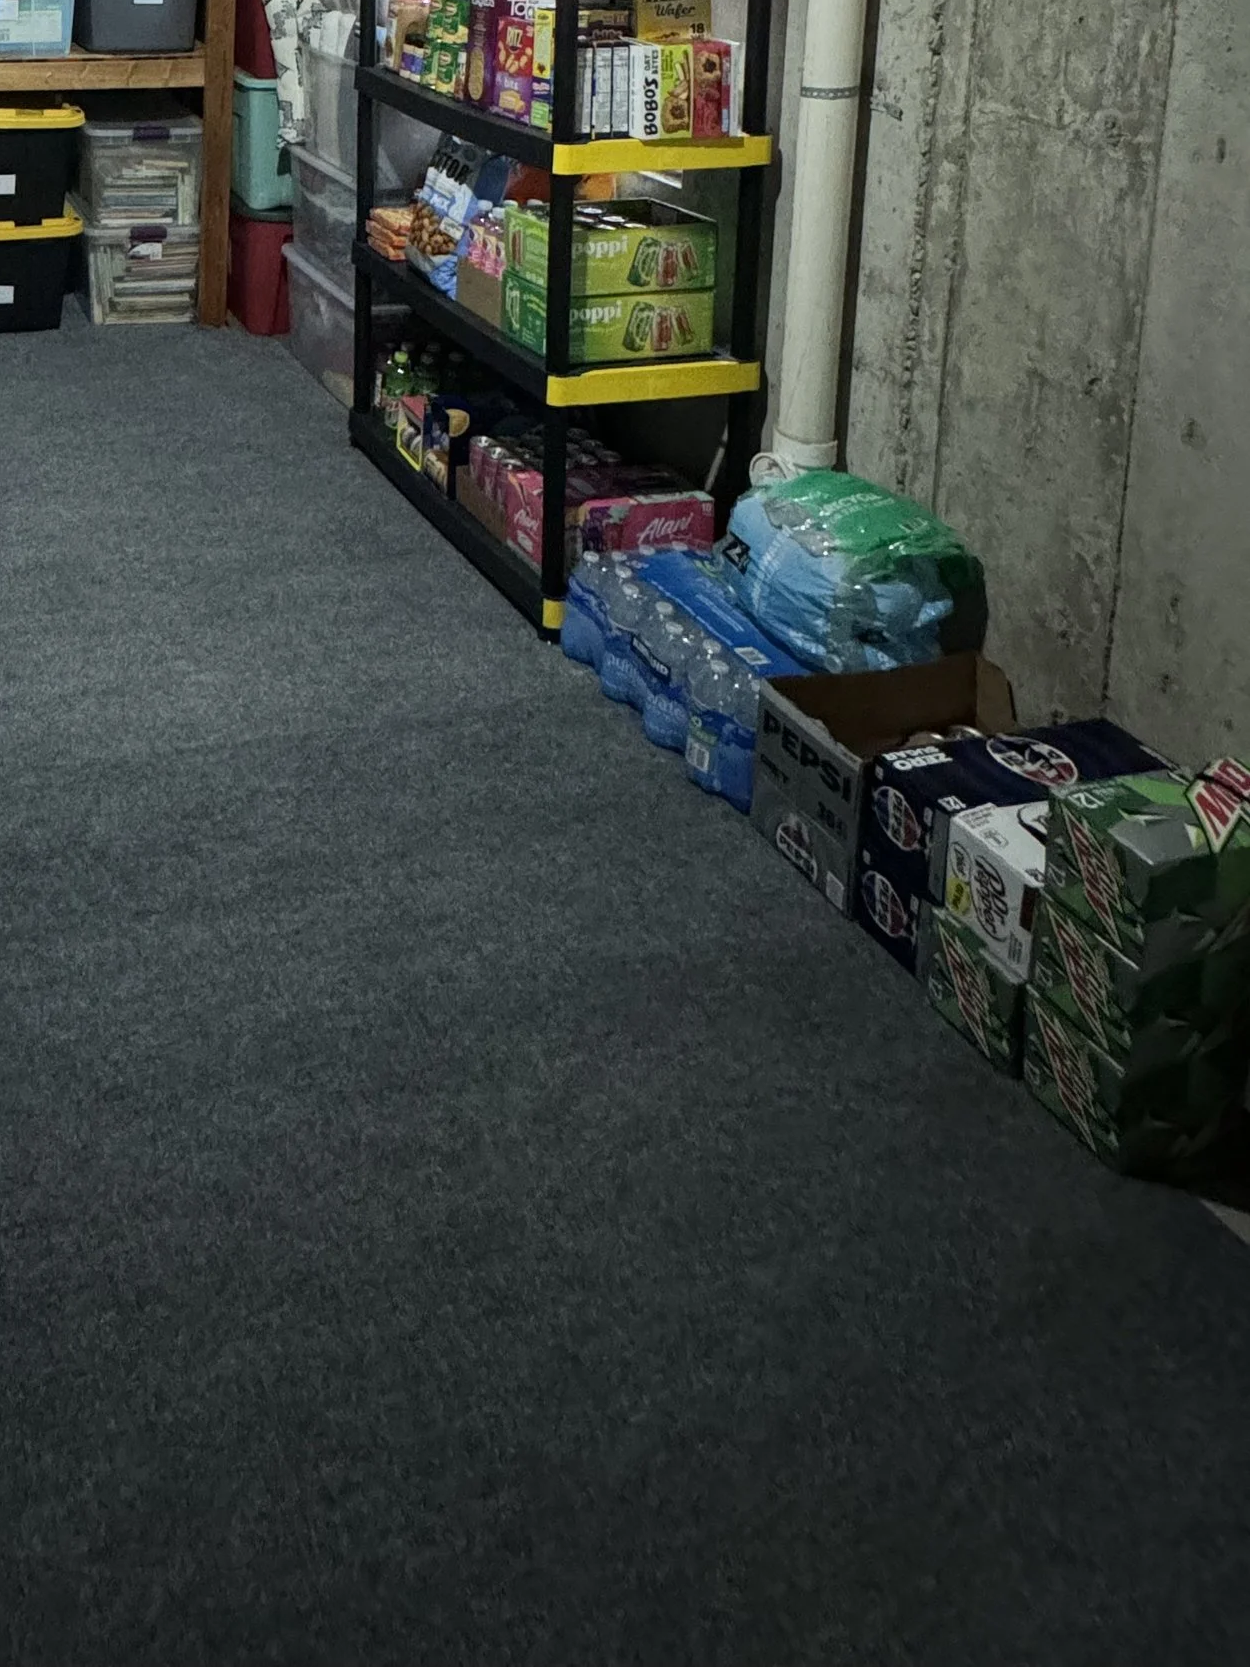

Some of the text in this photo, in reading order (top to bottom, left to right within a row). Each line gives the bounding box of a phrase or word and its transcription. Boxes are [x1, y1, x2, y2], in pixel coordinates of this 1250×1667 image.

[654, 2, 696, 19] Wafer
[689, 22, 705, 35] 18
[643, 76, 658, 136] BOBO'S
[572, 235, 629, 259] poppi
[569, 300, 623, 326] poppi
[763, 708, 852, 803] PEPSI
[892, 751, 954, 772] ZERO
[974, 859, 1005, 933] Pepper
